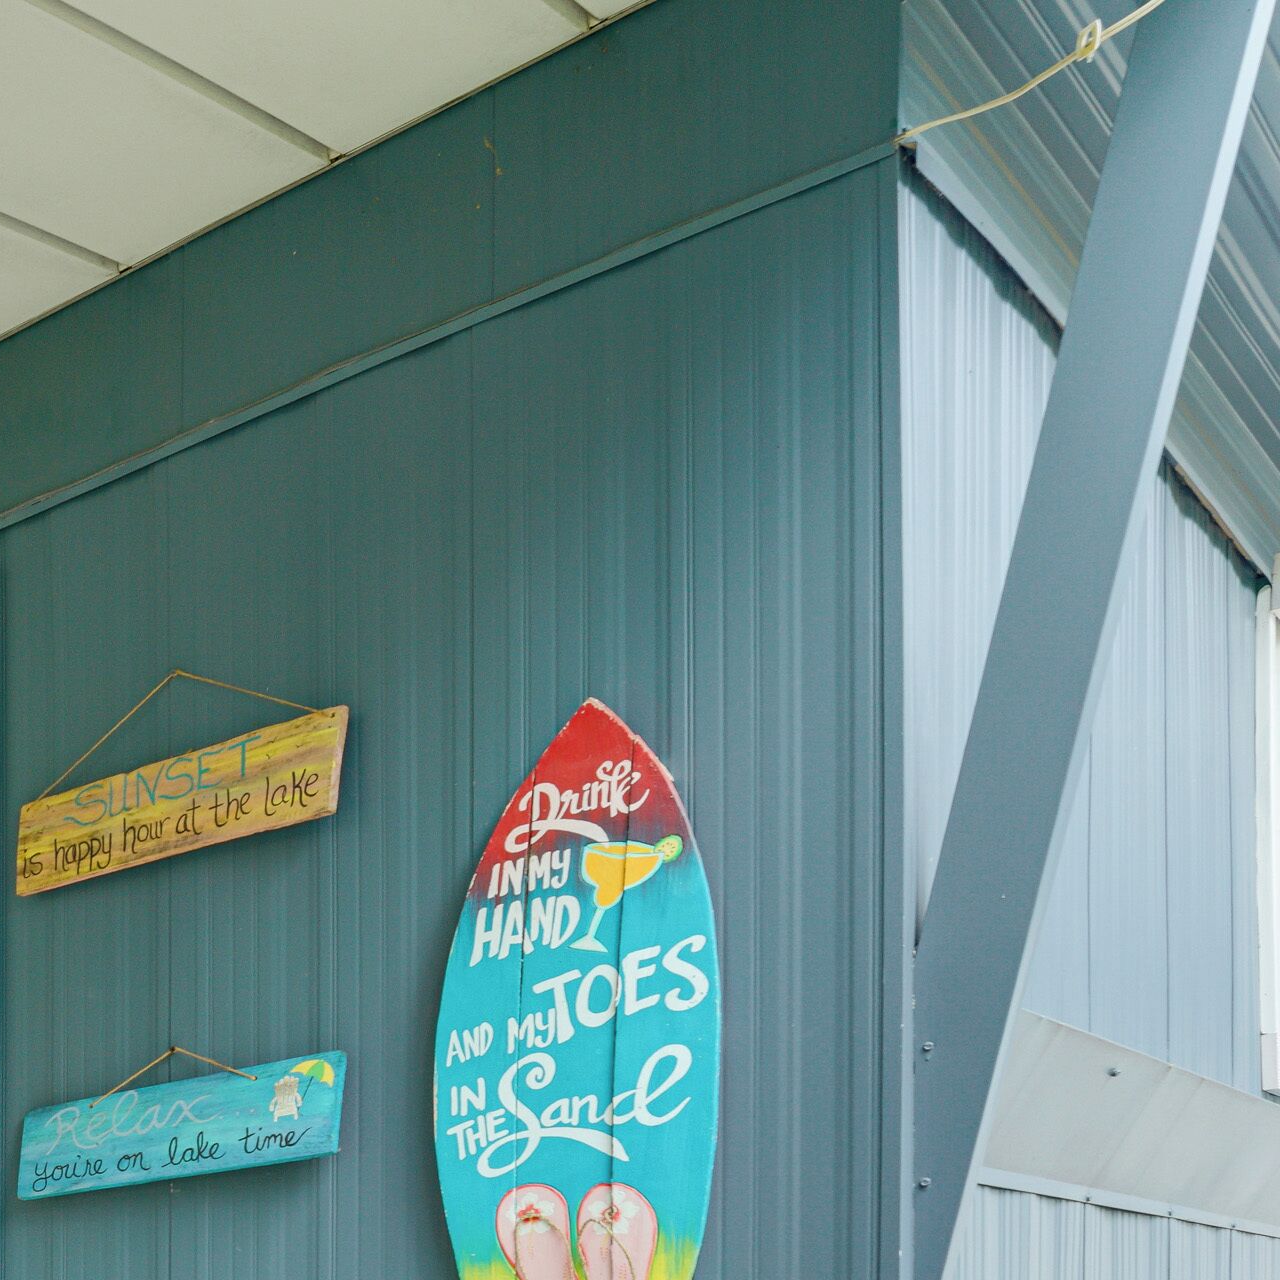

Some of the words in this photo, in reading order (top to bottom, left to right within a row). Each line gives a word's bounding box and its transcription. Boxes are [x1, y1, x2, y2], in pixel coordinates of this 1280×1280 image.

[64, 735, 262, 826] SUNSET
[504, 759, 650, 853] Drink
[23, 851, 43, 878] is
[54, 831, 113, 874] happy
[123, 817, 171, 854] hour
[175, 798, 201, 834] at
[209, 790, 252, 827] the
[487, 858, 526, 899] IN
[527, 848, 571, 890] MY
[469, 895, 581, 967] HAND
[446, 1022, 494, 1067] AND
[507, 1007, 557, 1054] MY
[532, 934, 710, 1044] TOES
[446, 1108, 509, 1161] THE
[450, 1077, 486, 1117] IN
[476, 1043, 693, 1179] Sand
[31, 1155, 108, 1193] you're
[116, 1150, 151, 1171] on
[161, 1131, 225, 1168] lake
[238, 1127, 312, 1152] time
